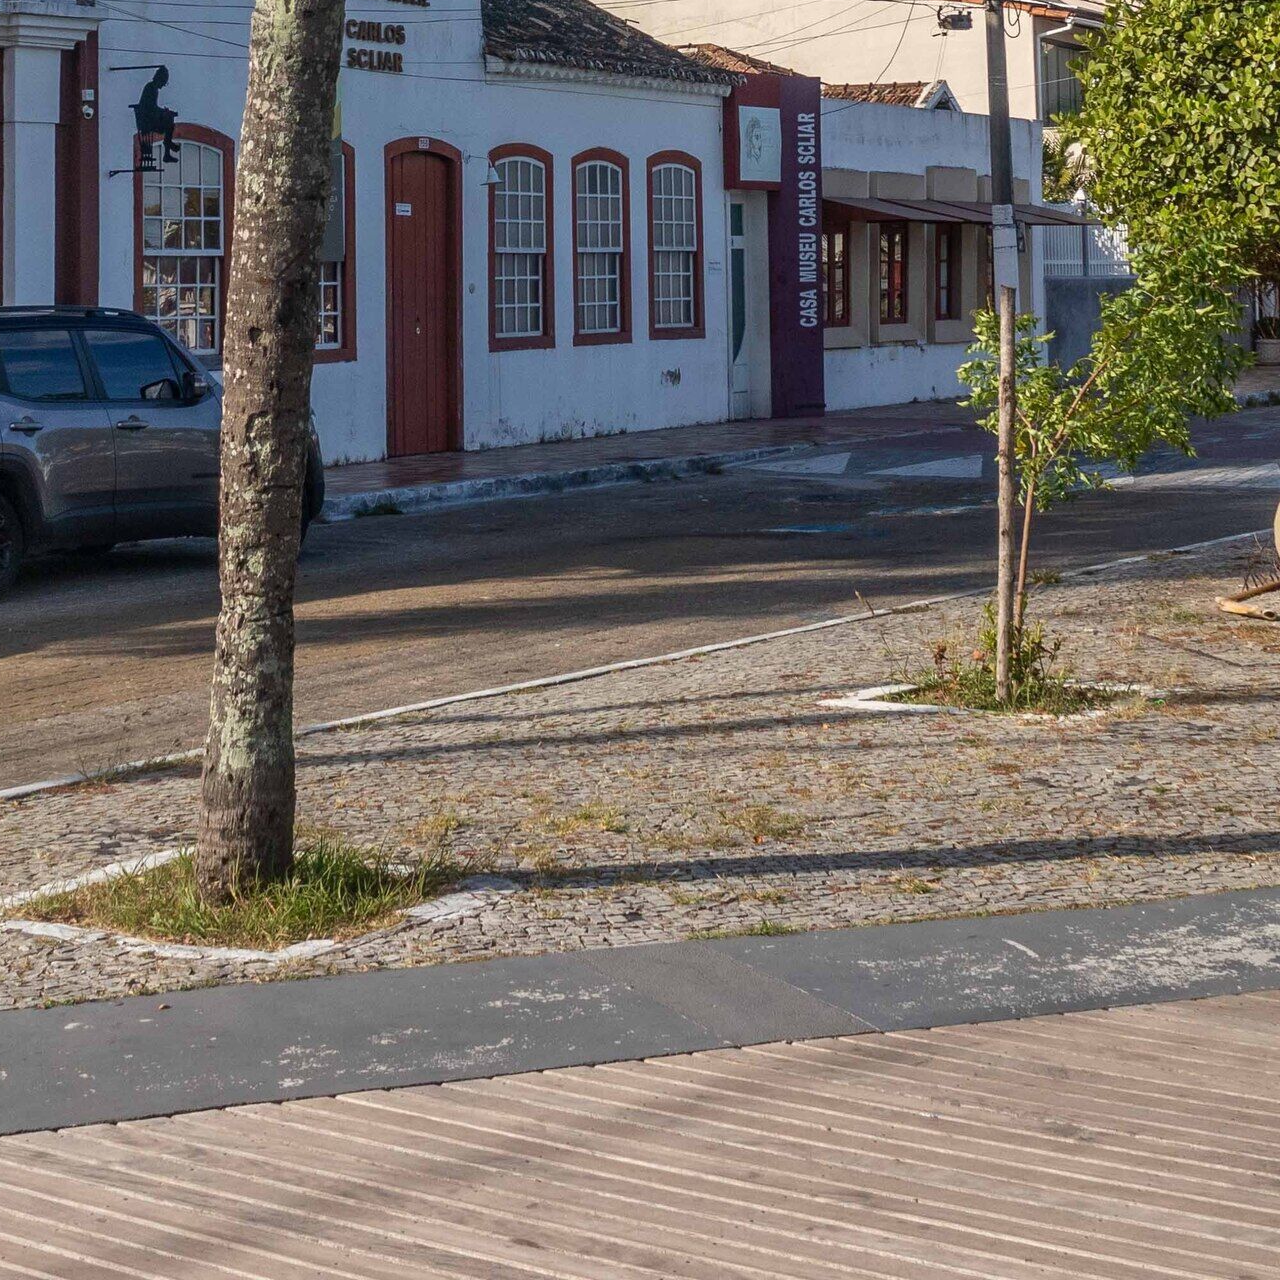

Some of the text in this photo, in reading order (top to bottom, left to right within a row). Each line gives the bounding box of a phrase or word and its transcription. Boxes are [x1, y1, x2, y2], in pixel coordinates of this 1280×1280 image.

[346, 19, 406, 46] CARLOS
[347, 48, 404, 73] SCLIAR
[797, 112, 818, 328] CASA MUSEU CARLOS SCLIAR
